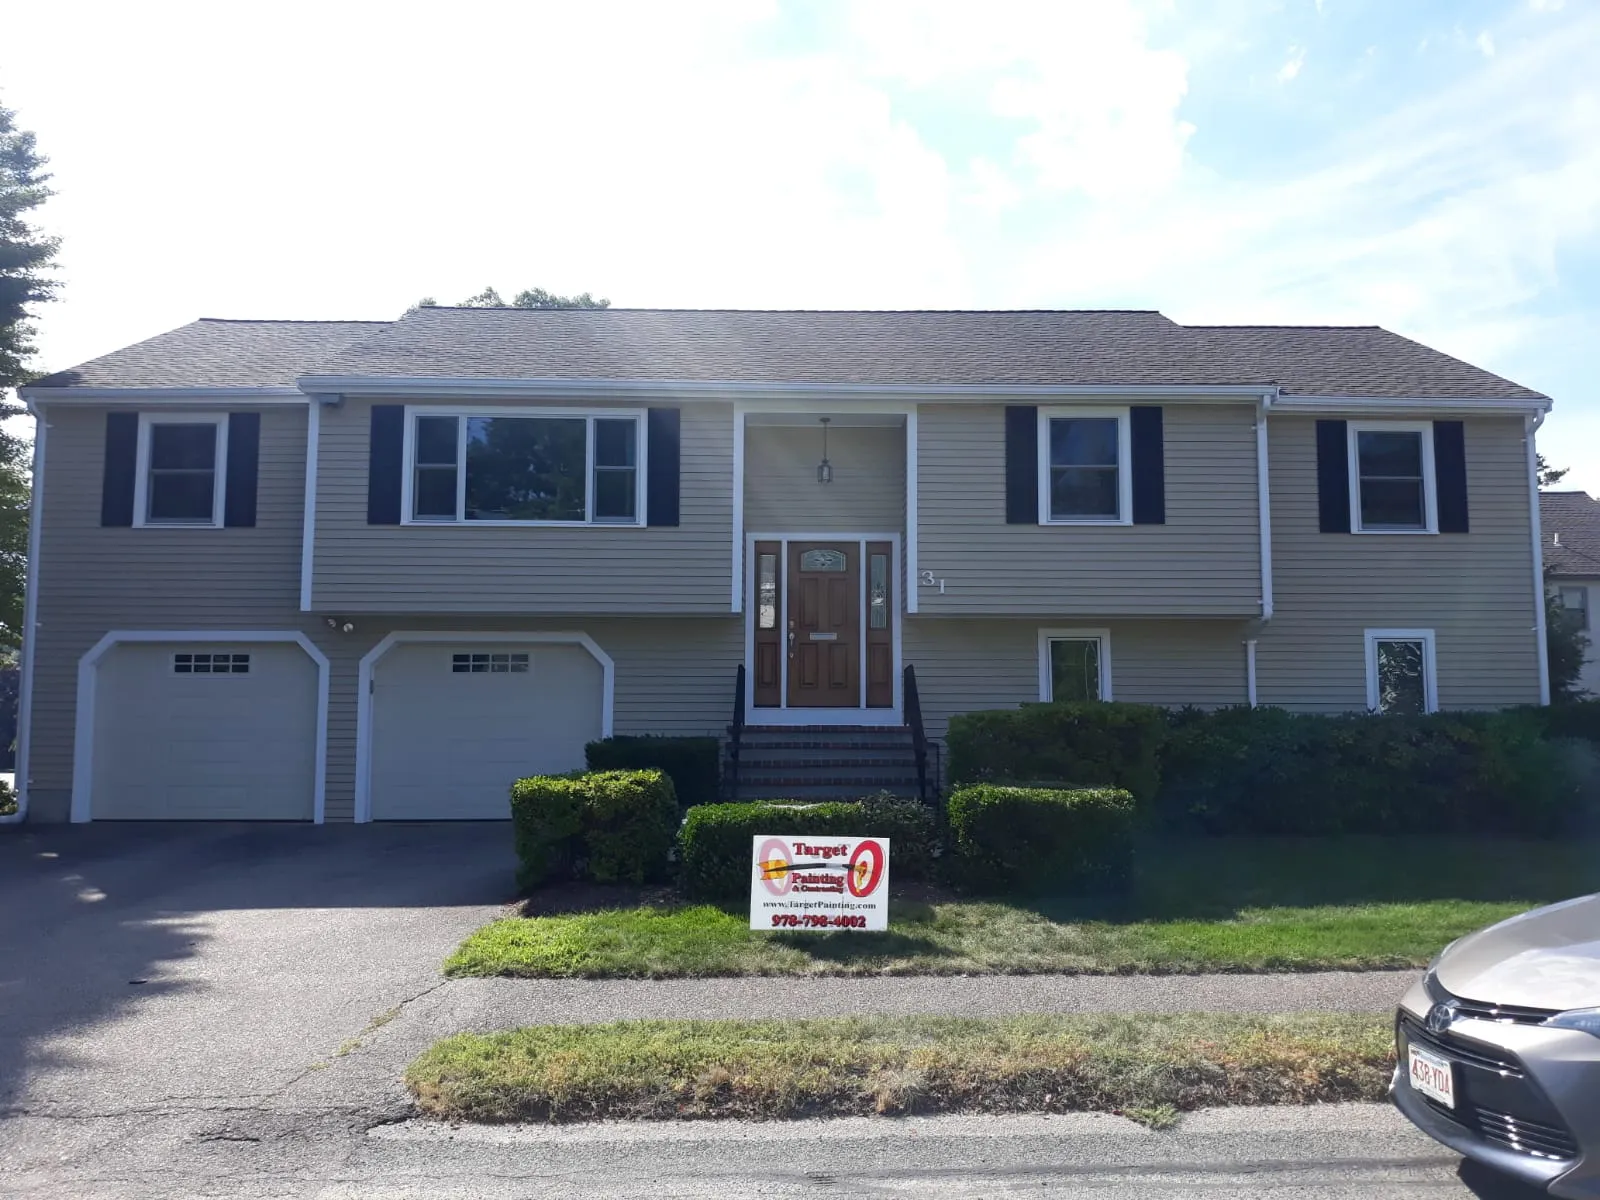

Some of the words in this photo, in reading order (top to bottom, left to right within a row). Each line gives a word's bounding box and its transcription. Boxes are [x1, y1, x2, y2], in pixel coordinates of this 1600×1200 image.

[921, 570, 945, 594] 31
[792, 842, 848, 859] Target
[791, 872, 845, 887] Painting
[763, 900, 877, 910] www.TargetPainting.com
[771, 914, 867, 928] 978-798-4002
